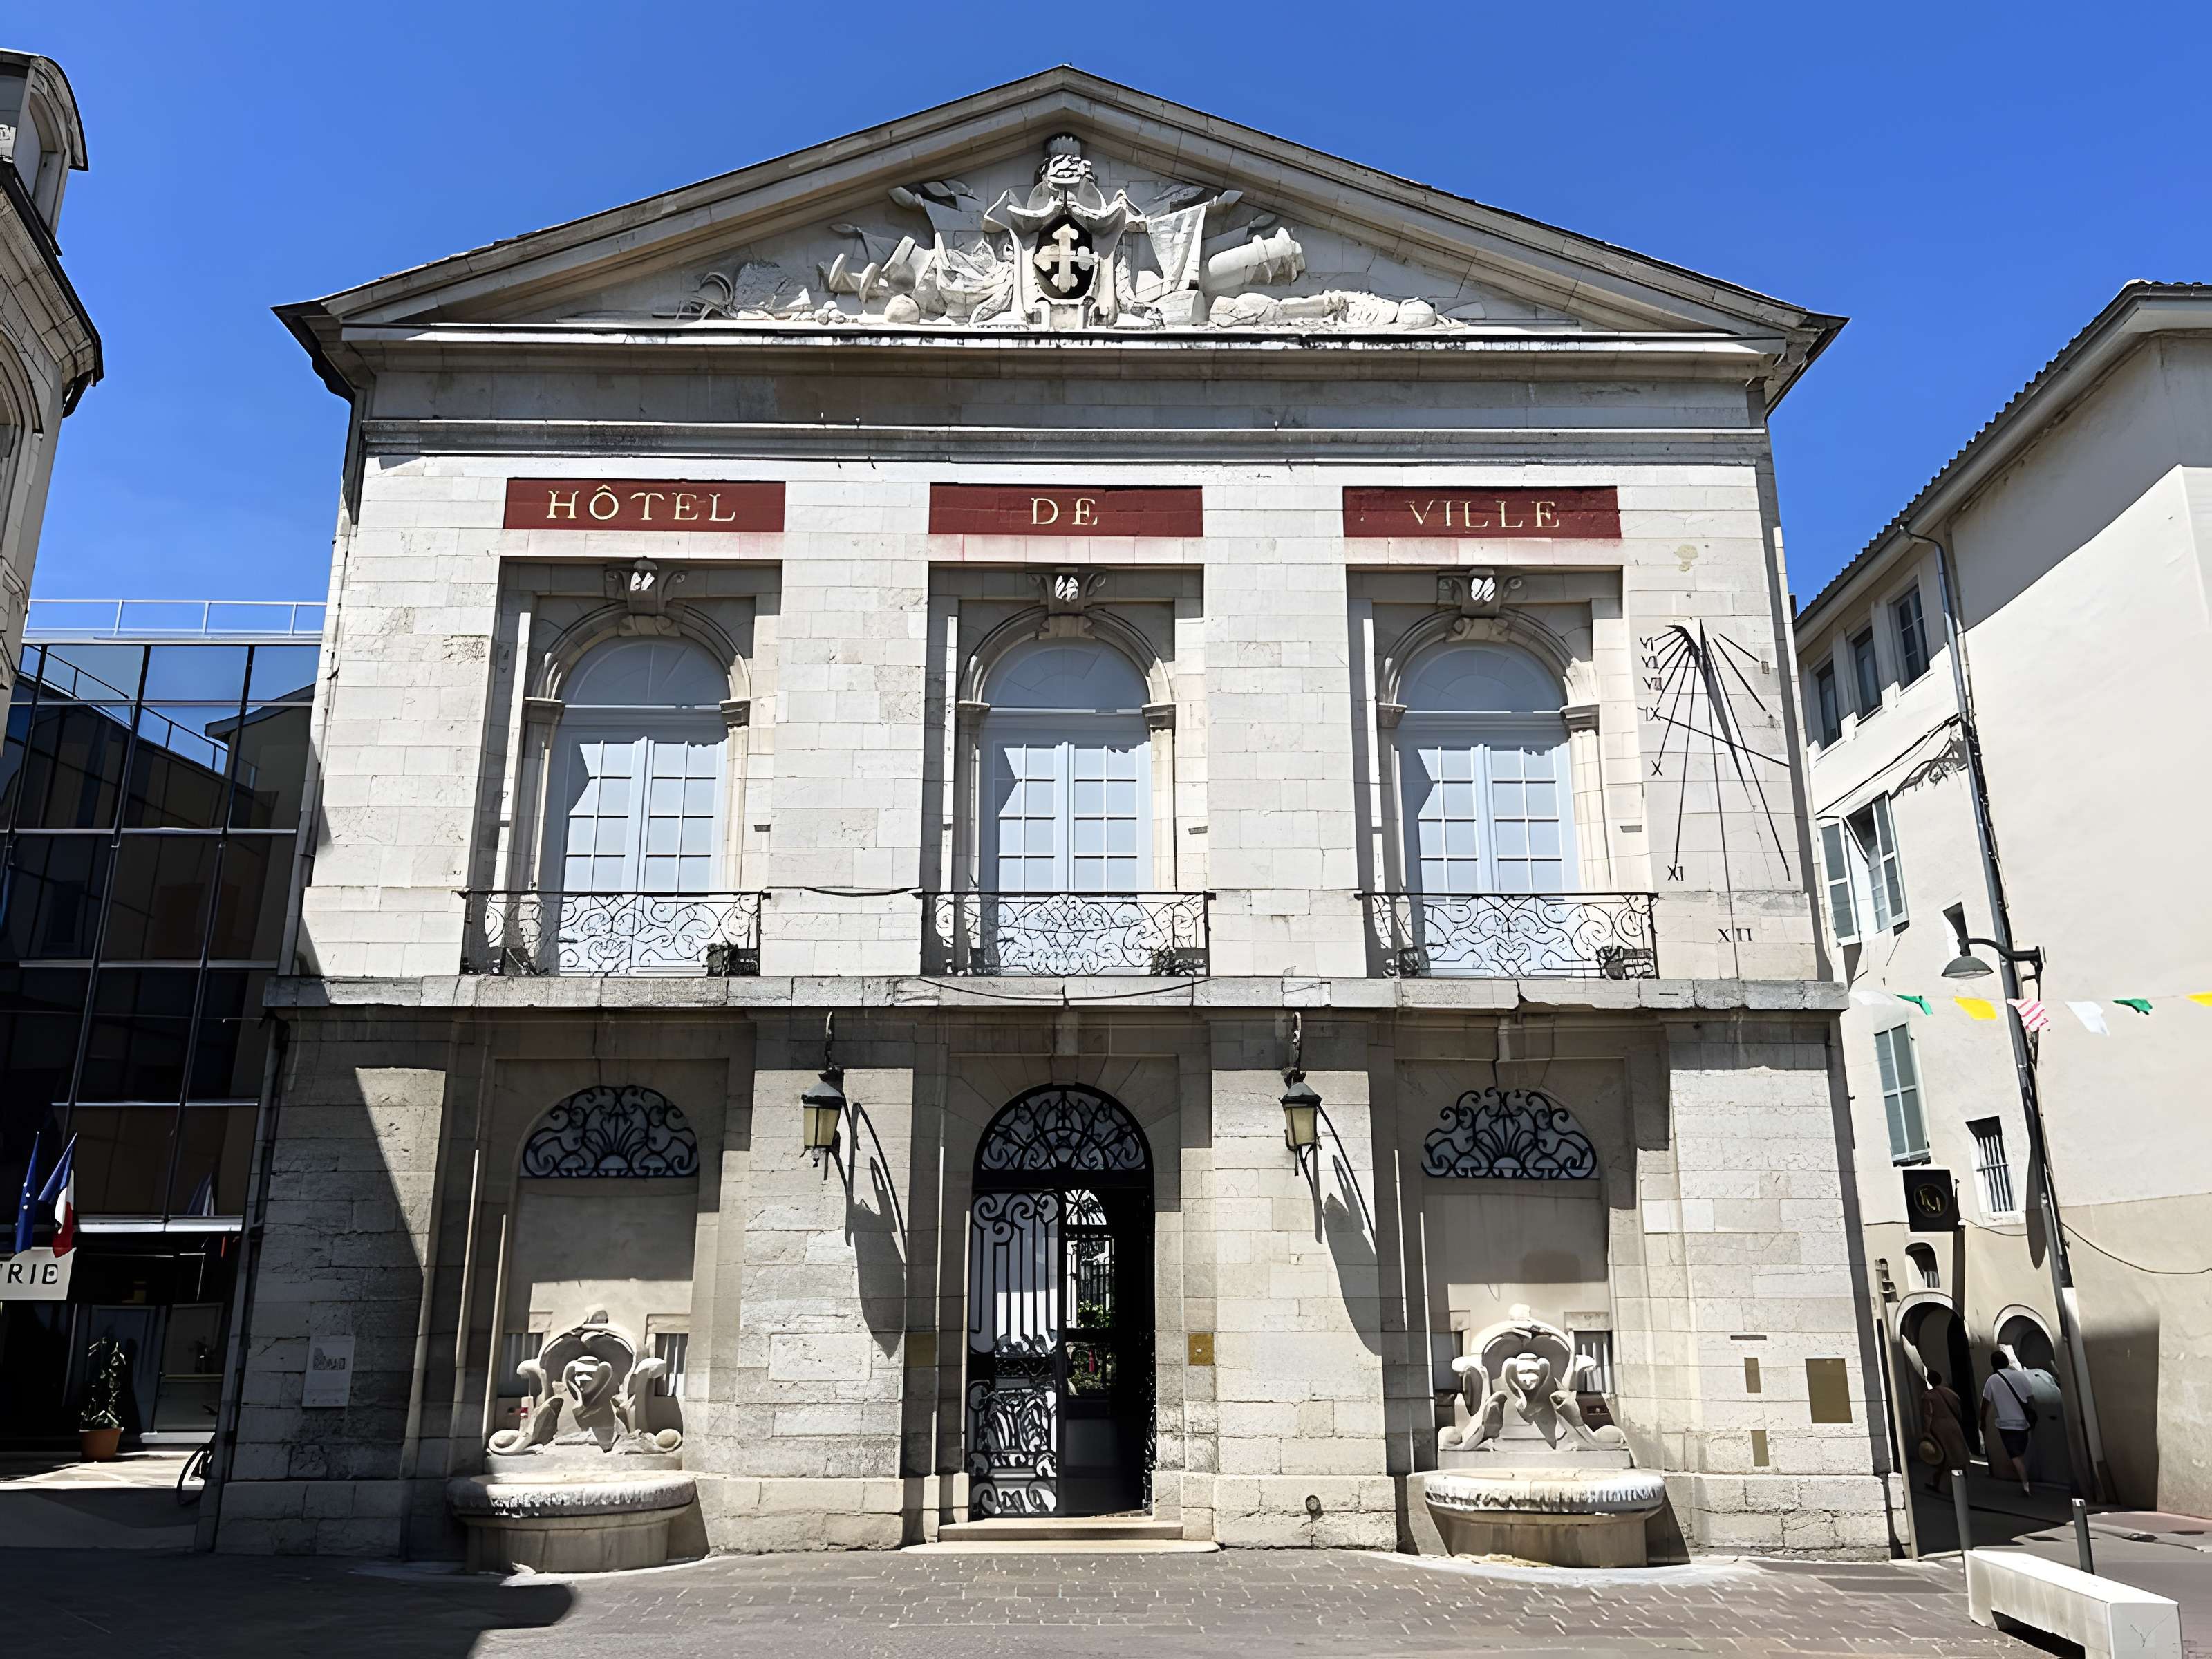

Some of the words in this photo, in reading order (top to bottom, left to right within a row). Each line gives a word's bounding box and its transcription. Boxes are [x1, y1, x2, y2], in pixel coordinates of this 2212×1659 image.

[546, 484, 736, 521] HÔTEL
[1030, 497, 1098, 525] DE
[1404, 499, 1560, 528] VILLE
[1651, 760, 1663, 777] X
[1667, 865, 1685, 881] XI
[0, 1263, 59, 1285] RIE
